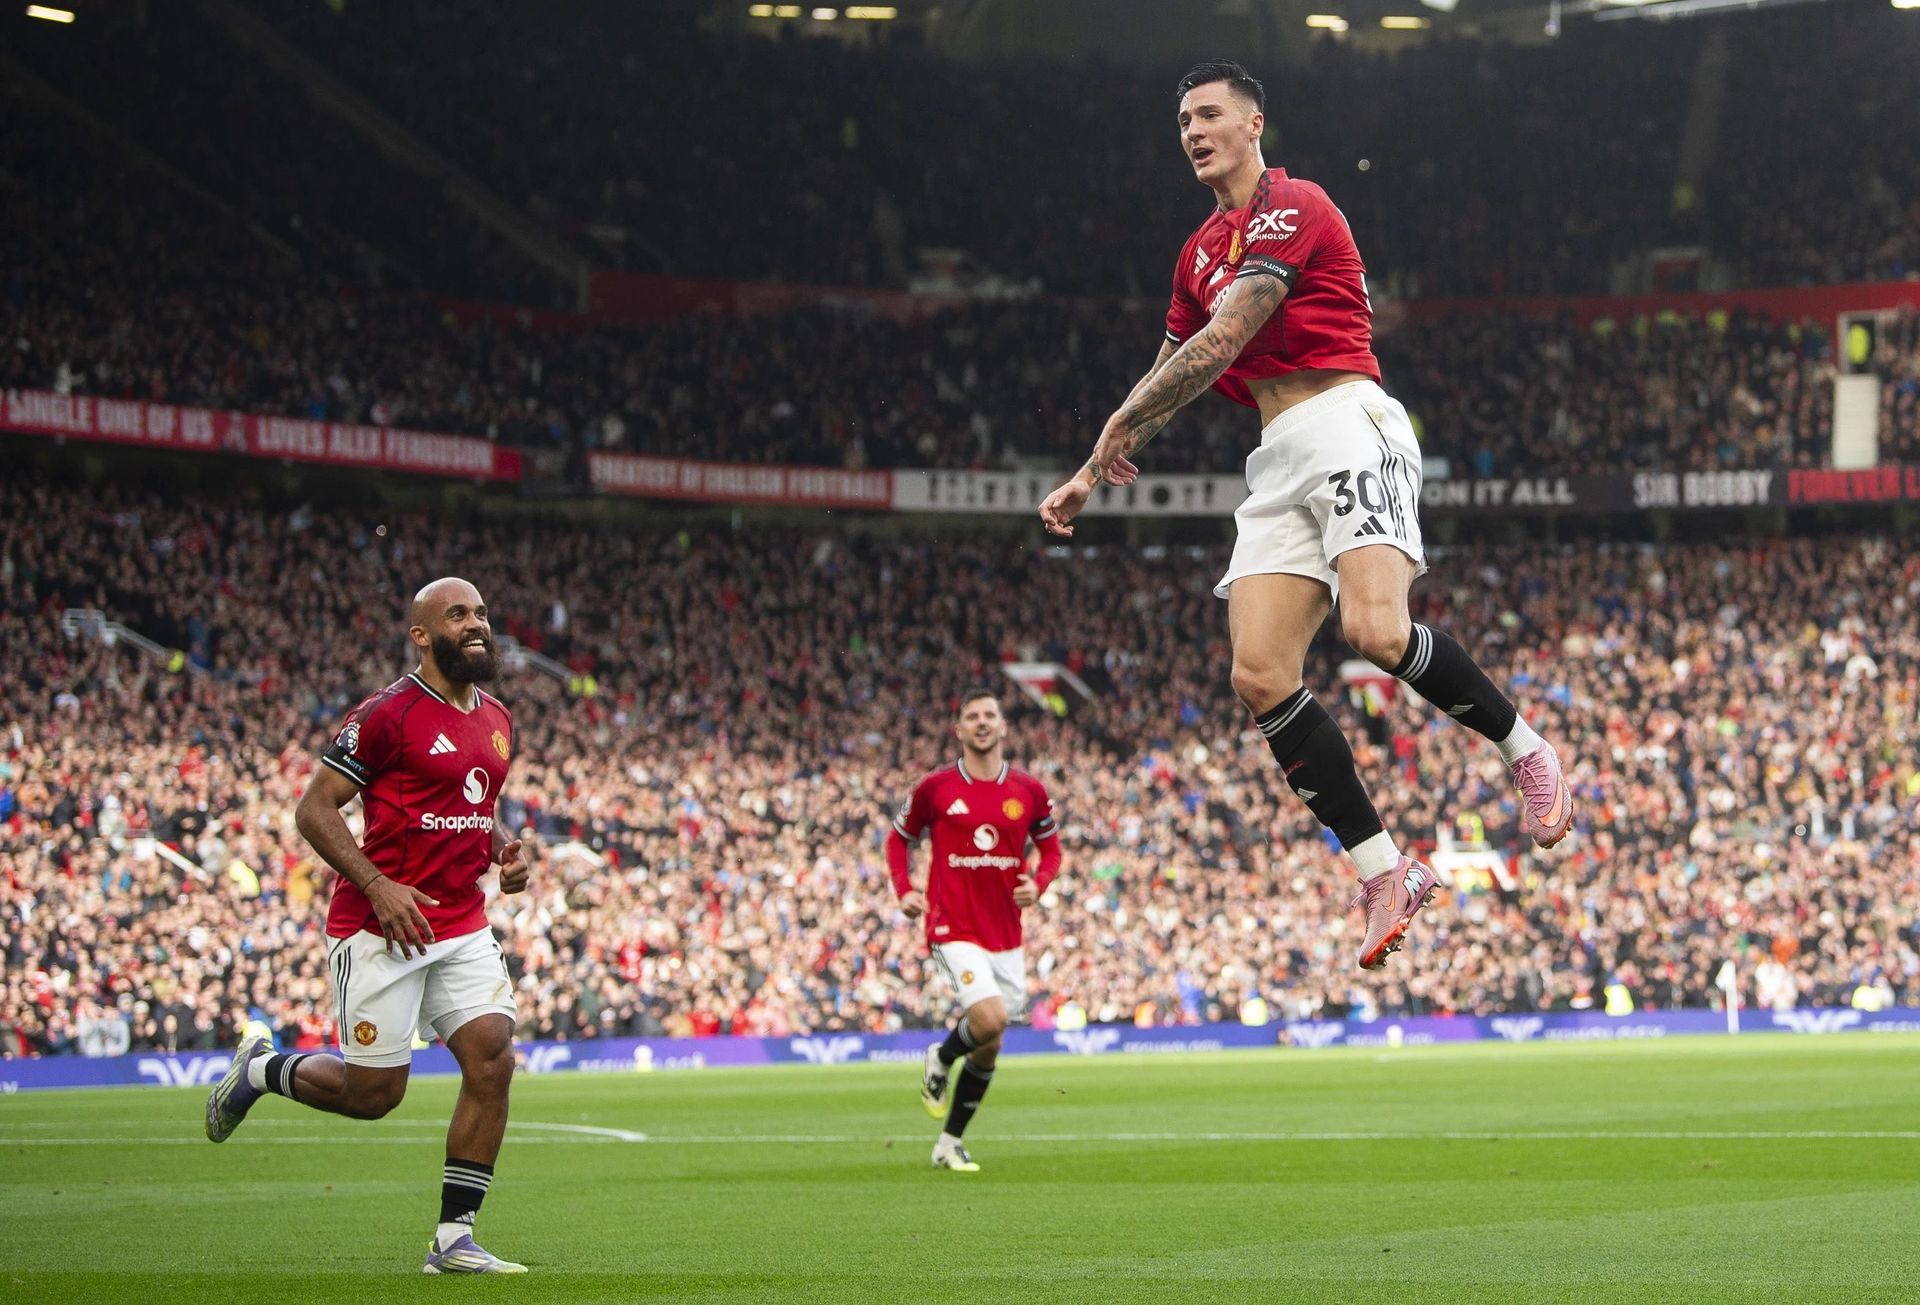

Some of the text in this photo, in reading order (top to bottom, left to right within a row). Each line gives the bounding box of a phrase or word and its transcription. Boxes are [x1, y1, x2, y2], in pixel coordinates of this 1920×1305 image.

[7, 388, 214, 444] SINGLE ONE OF US
[256, 415, 325, 456] LOVES
[1328, 469, 1386, 516] 30
[1474, 479, 1509, 507] IT
[1511, 477, 1577, 506] ALL
[1633, 469, 1773, 508] SIR BOBBY
[948, 853, 1020, 870] Snapdragon
